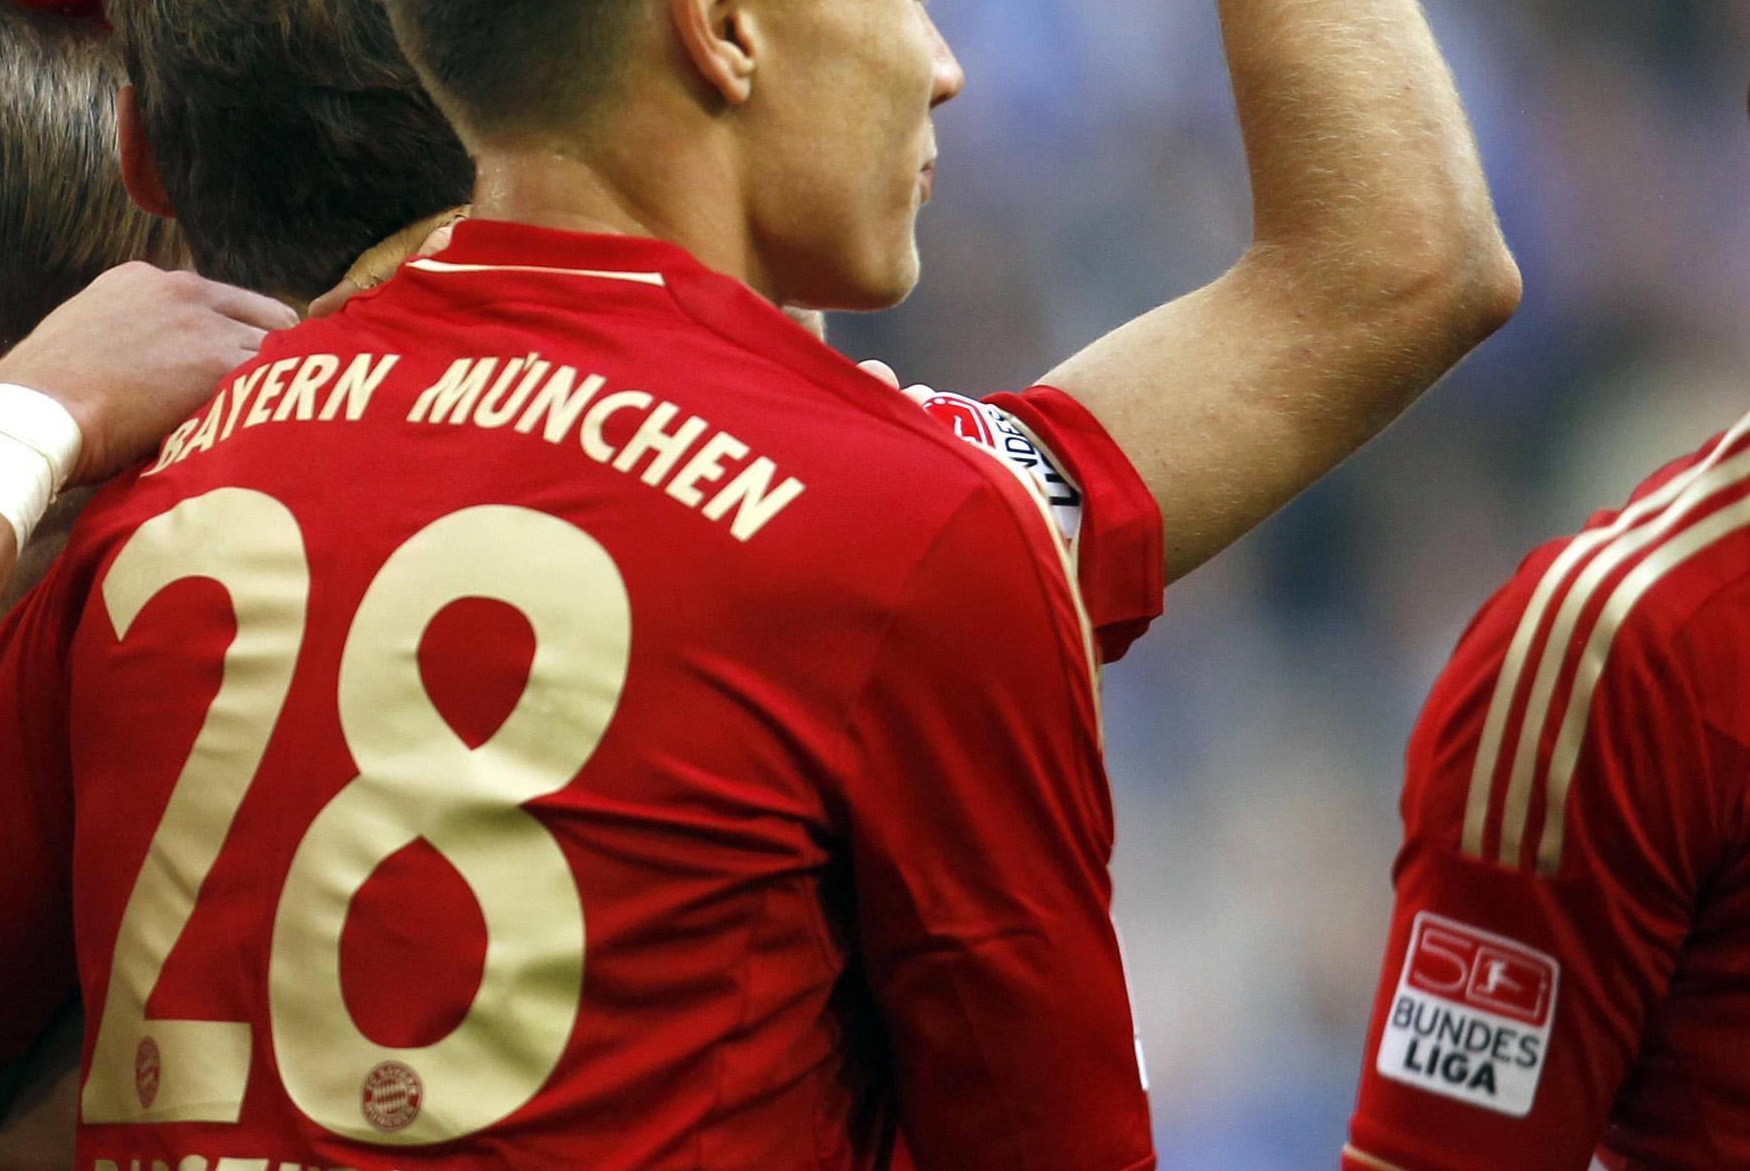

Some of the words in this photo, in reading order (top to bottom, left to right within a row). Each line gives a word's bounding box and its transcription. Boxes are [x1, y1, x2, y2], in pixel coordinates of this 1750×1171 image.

[139, 352, 401, 478] BAYERN
[407, 352, 805, 543] MÜNCHEN
[80, 486, 632, 1147] 28
[1393, 997, 1540, 1069] BUNDES
[1404, 1039, 1498, 1096] LIGA
